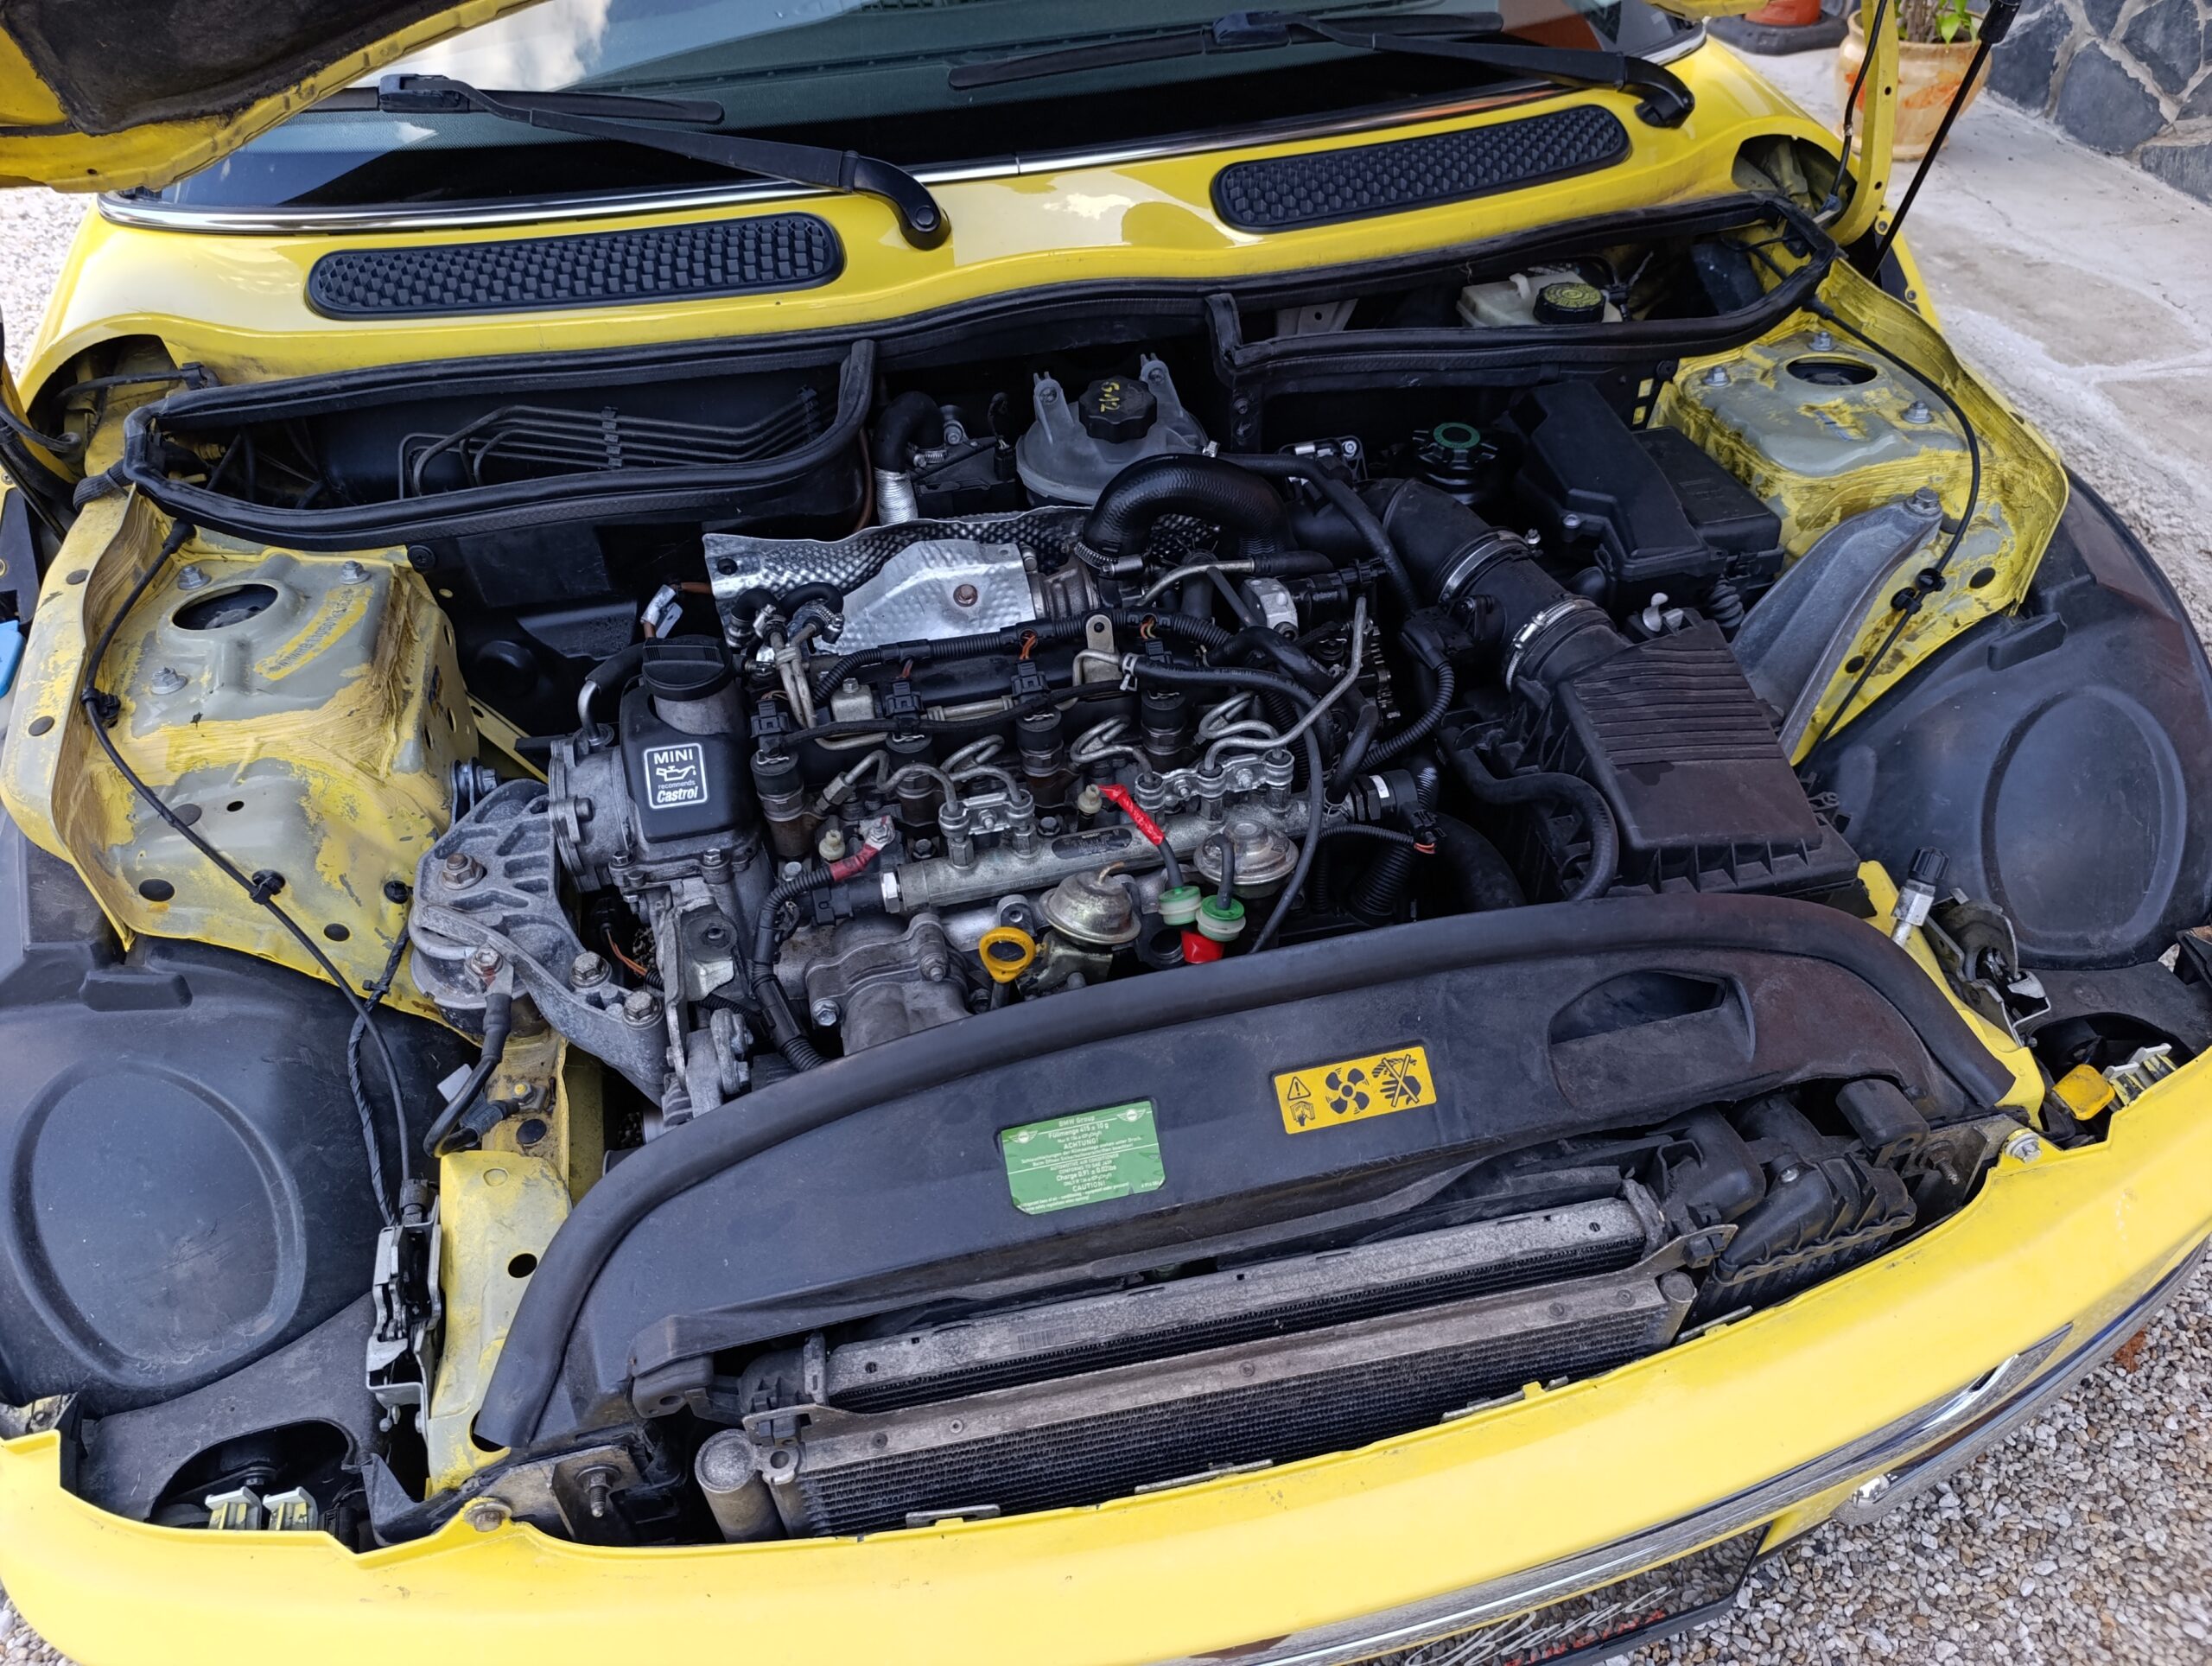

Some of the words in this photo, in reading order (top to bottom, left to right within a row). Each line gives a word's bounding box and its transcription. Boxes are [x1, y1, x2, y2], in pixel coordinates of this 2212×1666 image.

[654, 748, 693, 765] MINI
[658, 779, 696, 790] recommends
[657, 786, 698, 803] Castrol
[1058, 1119, 1076, 1128] BMW
[1076, 1115, 1095, 1124] Group
[1048, 1129, 1079, 1140] Füllmenge
[1064, 1138, 1099, 1149] ACHTUNG!
[1057, 1173, 1077, 1183] Charge
[1072, 1180, 1106, 1192] CAUTION!
